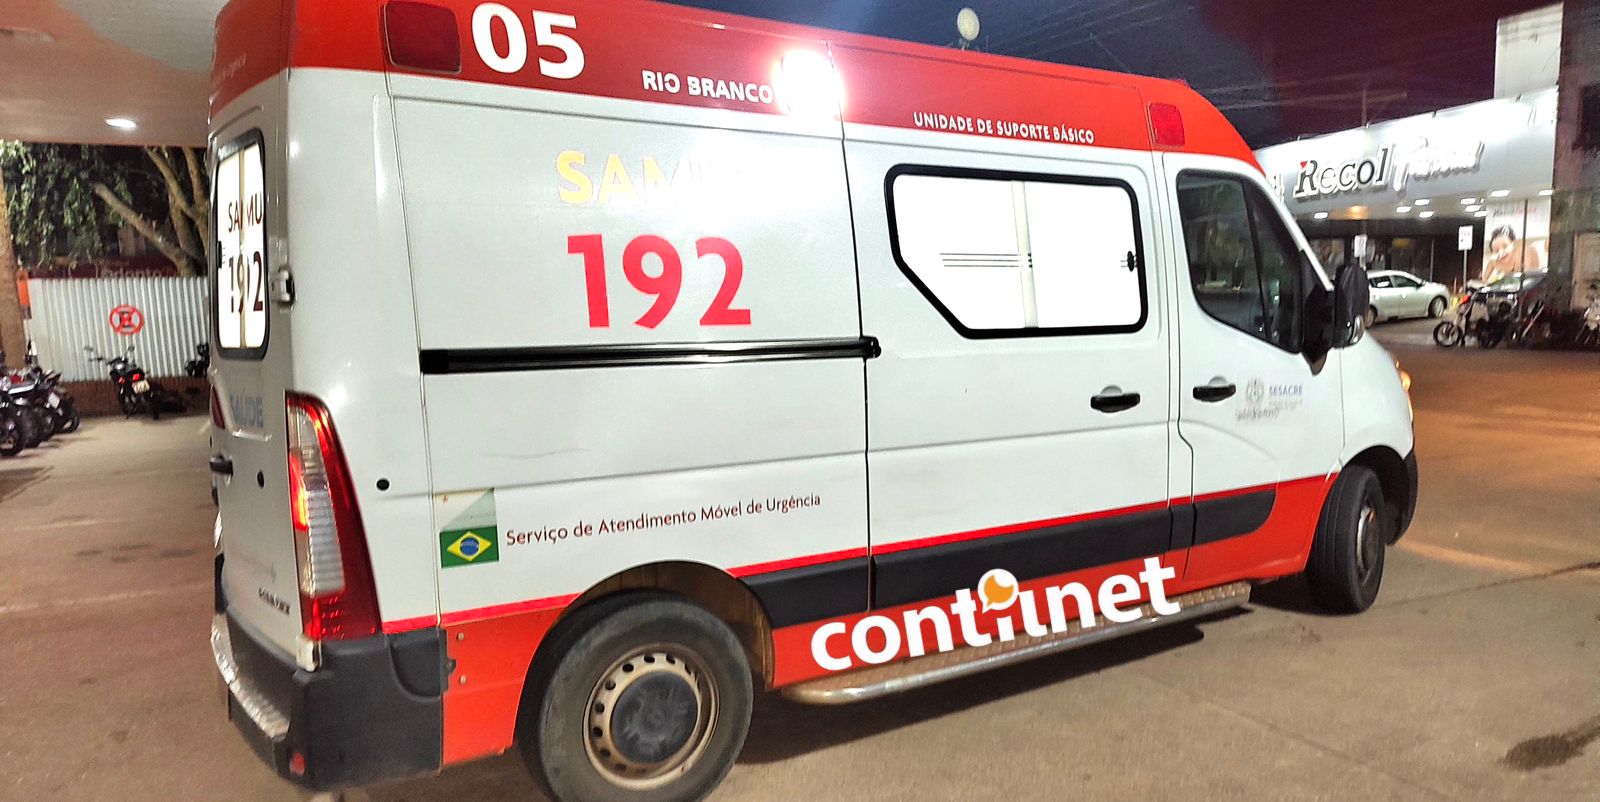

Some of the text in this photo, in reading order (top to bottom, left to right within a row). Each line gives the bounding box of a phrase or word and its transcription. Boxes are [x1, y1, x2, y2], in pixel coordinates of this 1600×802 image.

[471, 2, 586, 80] 05
[642, 69, 774, 104] RIO BRANCO
[913, 111, 1095, 144] UNIDADE DE SUPORTE BÁSICO
[556, 150, 714, 206] SAM
[1294, 146, 1390, 197] Recol
[228, 191, 264, 233] SAMU
[228, 250, 264, 315] 192
[567, 233, 752, 329] 192
[506, 491, 822, 546] Serviço de Atendimento Móvel de Urgência
